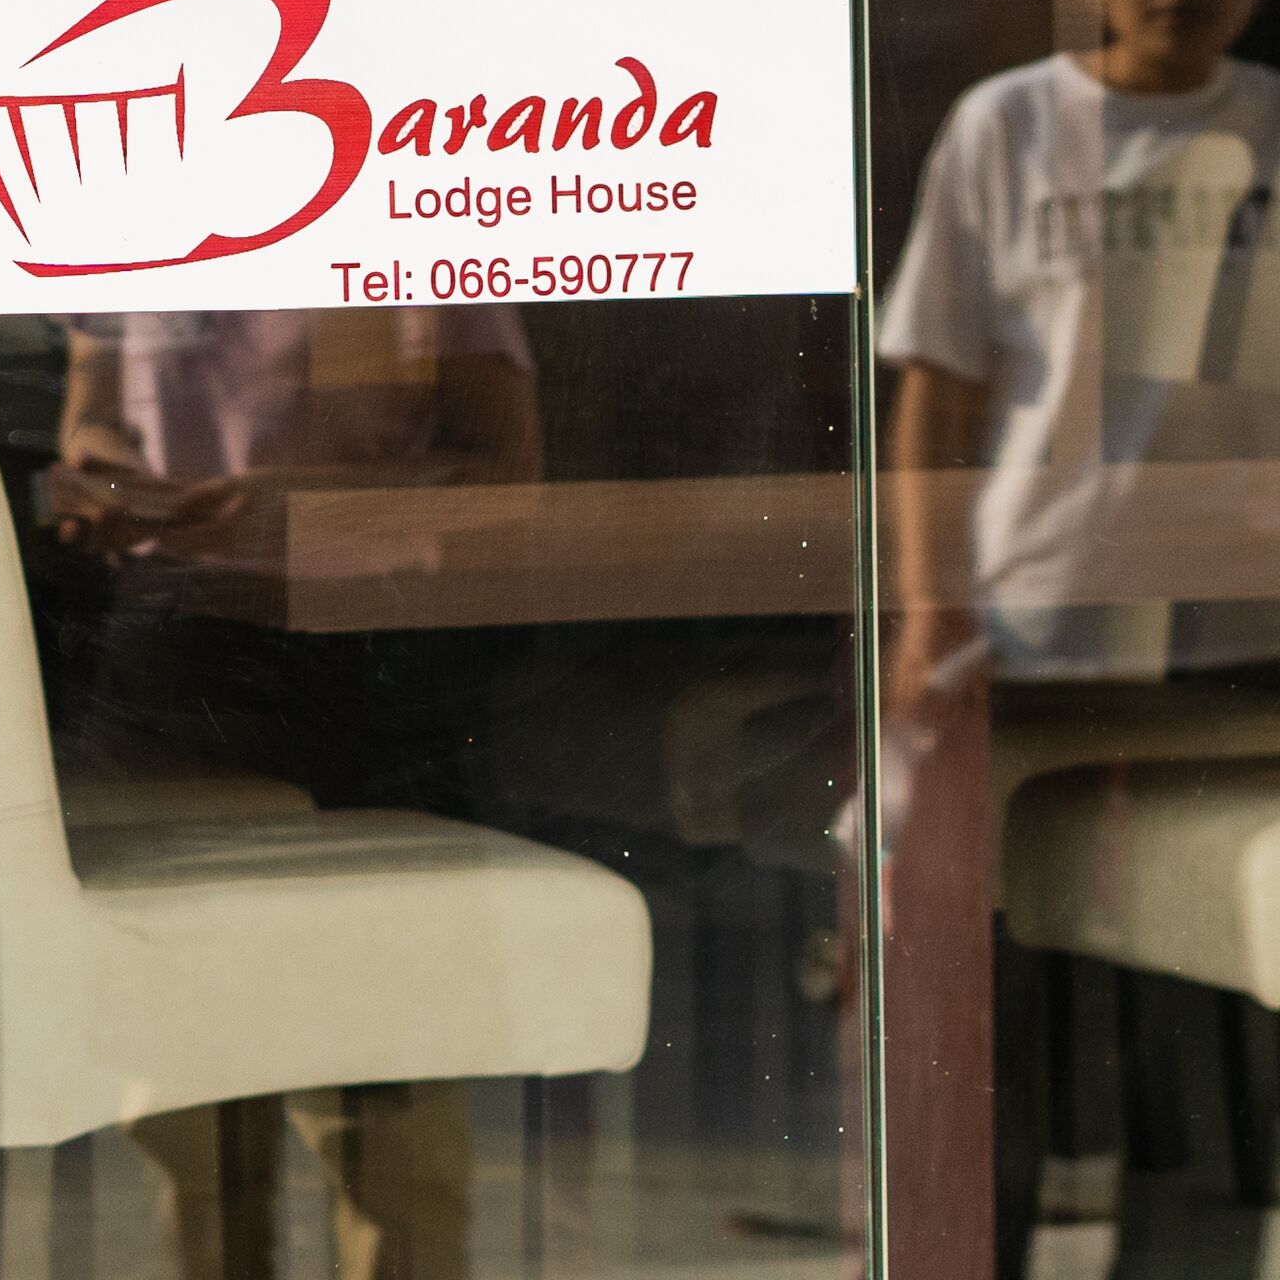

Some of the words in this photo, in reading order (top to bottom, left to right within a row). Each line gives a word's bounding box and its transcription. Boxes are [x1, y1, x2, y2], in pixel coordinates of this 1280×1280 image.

[388, 176, 532, 228] Lodge
[551, 175, 697, 214] House
[330, 259, 414, 303] Tel:
[430, 251, 694, 300] 066-590777
